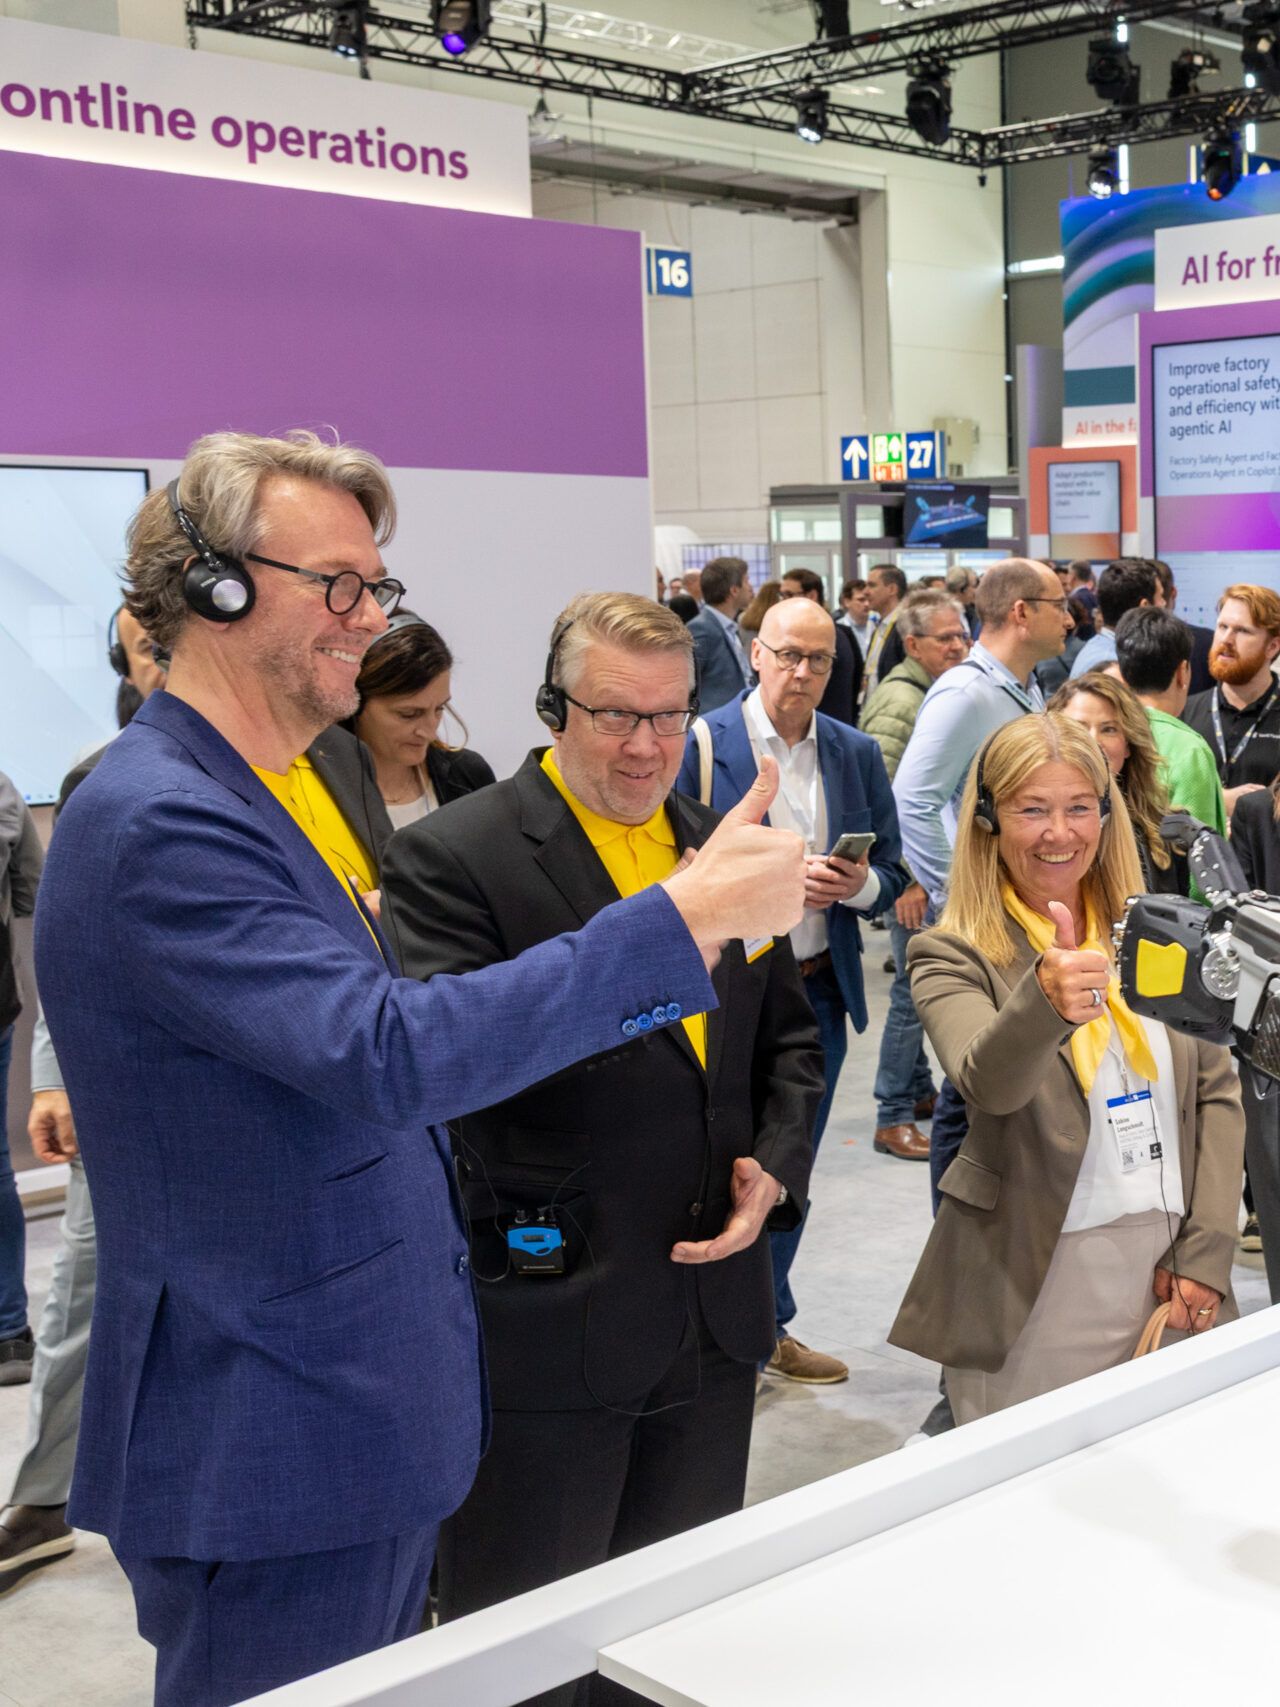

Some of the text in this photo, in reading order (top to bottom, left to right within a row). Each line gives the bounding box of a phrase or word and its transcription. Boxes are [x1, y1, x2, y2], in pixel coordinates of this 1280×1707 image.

[211, 115, 469, 180] operations
[658, 257, 689, 288] 16
[1181, 254, 1209, 286] AI
[1216, 250, 1257, 282] for
[1168, 356, 1270, 379] Improve factory
[1168, 377, 1241, 400] operational
[1168, 401, 1193, 417] and
[1195, 398, 1257, 416] efficiency
[1075, 421, 1088, 435] AI
[1091, 420, 1103, 435] in
[1105, 419, 1125, 434] the
[1169, 419, 1232, 441] agentic AI
[909, 440, 933, 469] 27
[1168, 455, 1197, 467] Factory
[1199, 453, 1222, 466] Safety
[1225, 452, 1248, 465] Agent
[1249, 451, 1265, 462] and
[1169, 470, 1211, 481] Operations
[1213, 469, 1236, 481] Agent
[1238, 468, 1245, 477] in
[1246, 466, 1277, 478] Copilot
